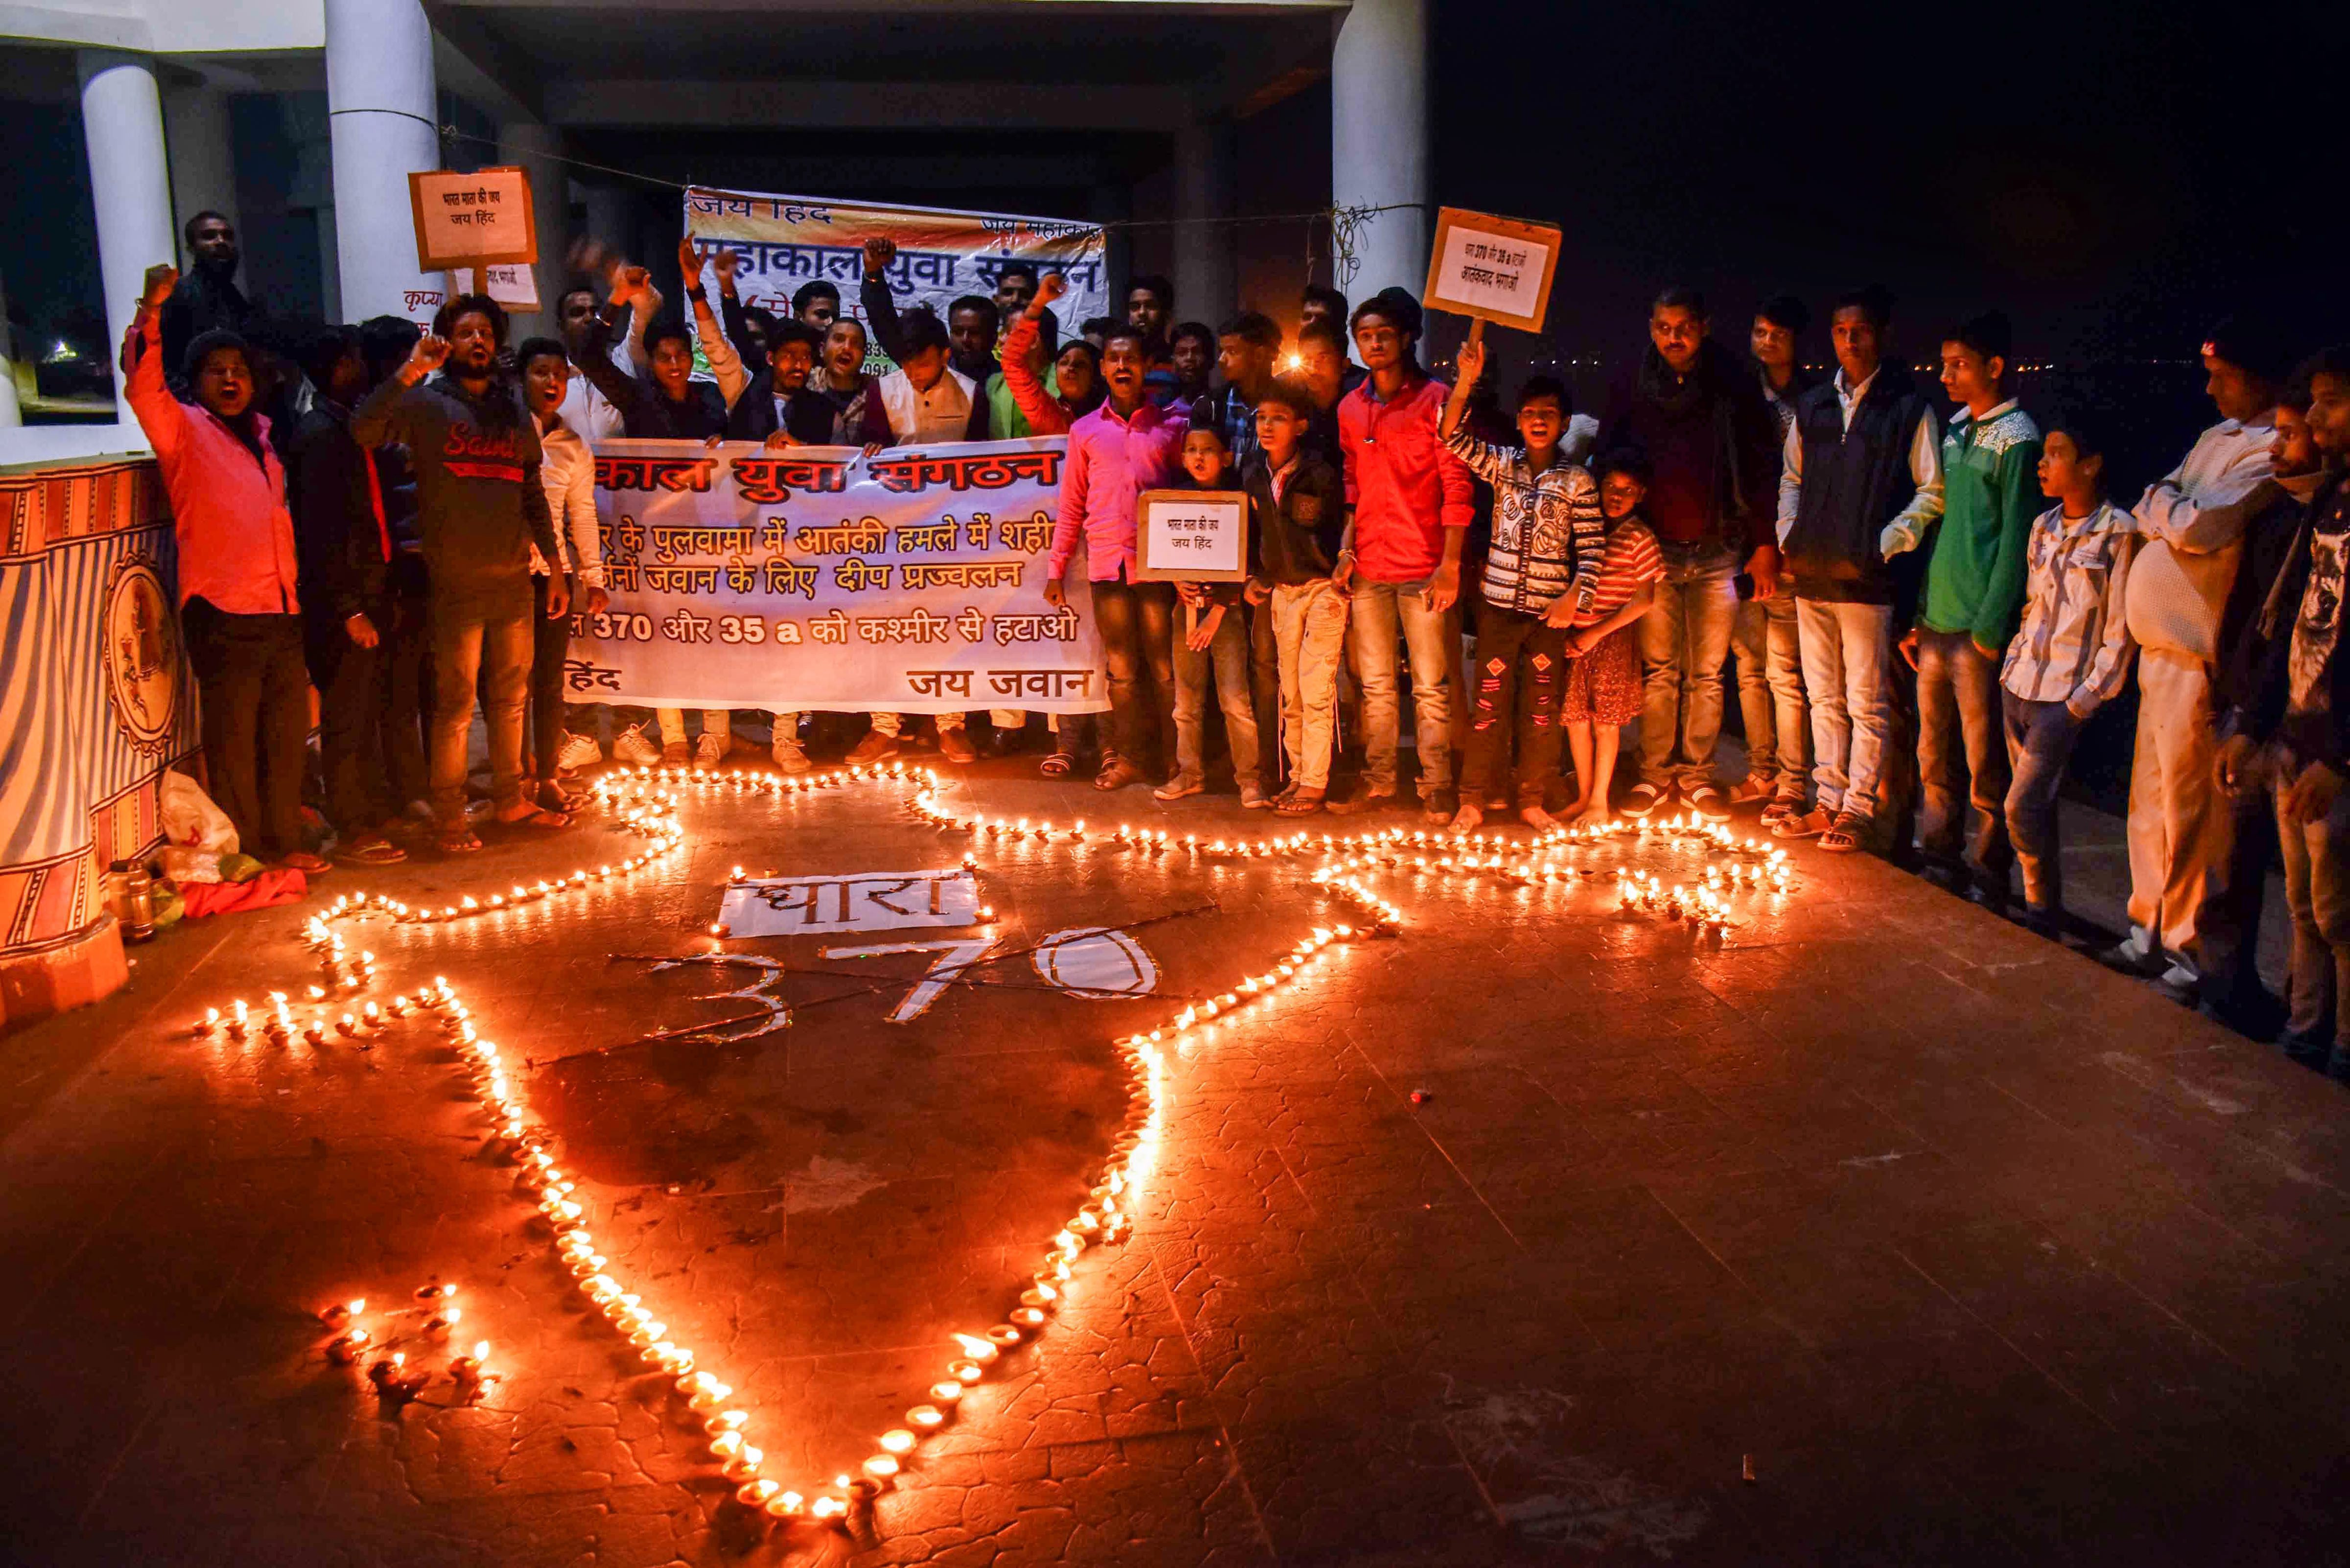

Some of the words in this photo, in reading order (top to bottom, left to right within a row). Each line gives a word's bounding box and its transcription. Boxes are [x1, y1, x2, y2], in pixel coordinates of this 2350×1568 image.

[443, 193, 460, 206] भारत
[461, 192, 476, 205] माता
[477, 187, 487, 205] की
[489, 191, 500, 204] जय
[691, 196, 751, 217] जय
[450, 214, 470, 225] जय
[476, 210, 495, 226] हिंद
[1475, 245, 1487, 259] 370
[1497, 249, 1506, 263] 35
[1461, 263, 1494, 288] आतंकवाद
[1496, 271, 1519, 291] भगाओ
[596, 455, 718, 492] काल
[730, 458, 856, 504] युवा
[867, 451, 1065, 492] संगठन
[618, 515, 646, 553] के
[652, 525, 755, 563] पुलवामा
[762, 516, 787, 554] में
[795, 515, 889, 555] आतंकी
[895, 514, 959, 554] हमले
[967, 512, 992, 551] में
[1000, 510, 1056, 555] शही
[1167, 518, 1182, 531] भारत
[1184, 519, 1197, 531] माता
[1198, 515, 1206, 531] की
[1208, 519, 1219, 531] जय
[1172, 538, 1190, 548] जय
[1194, 536, 1212, 549] हिंद
[644, 564, 720, 593] जवान
[726, 556, 756, 593] के
[763, 555, 820, 600] लिए
[835, 557, 893, 592] दीप
[900, 562, 1025, 589] प्रज्वलन
[593, 611, 653, 642] 370
[662, 608, 712, 644] और
[719, 615, 766, 645] 35
[776, 620, 803, 645] a
[808, 608, 850, 645] को
[856, 607, 950, 644] कश्मीर
[955, 606, 985, 642] से
[992, 605, 1080, 647] हटाओ
[906, 670, 974, 697] जय
[987, 670, 1094, 698] जवान
[649, 925, 1164, 1045] 370
